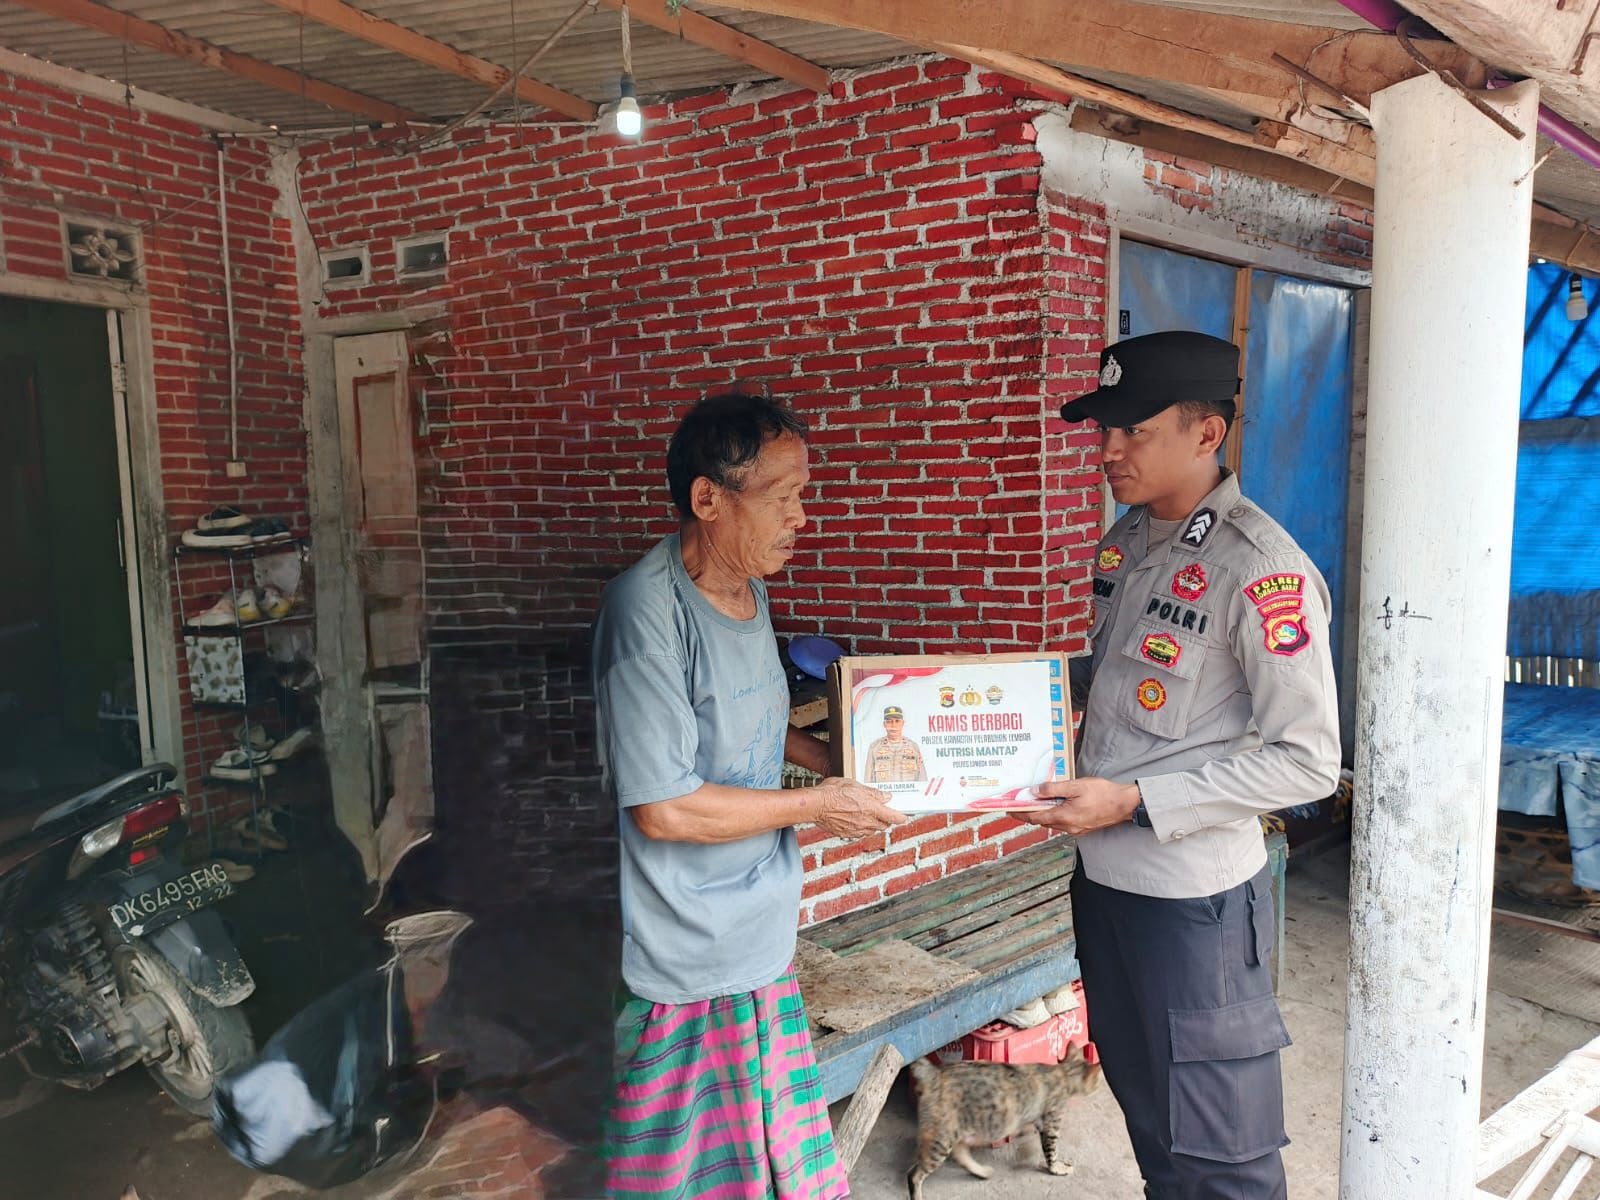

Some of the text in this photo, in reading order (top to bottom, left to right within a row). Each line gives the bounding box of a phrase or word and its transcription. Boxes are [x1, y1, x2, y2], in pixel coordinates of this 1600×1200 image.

[1253, 576, 1299, 594] POLRES
[1147, 598, 1208, 634] POLRI
[928, 712, 1023, 732] KAMIS BERBAGI
[921, 735, 943, 744] POLSEK
[936, 745, 1018, 757] NUTRISI MANTAP
